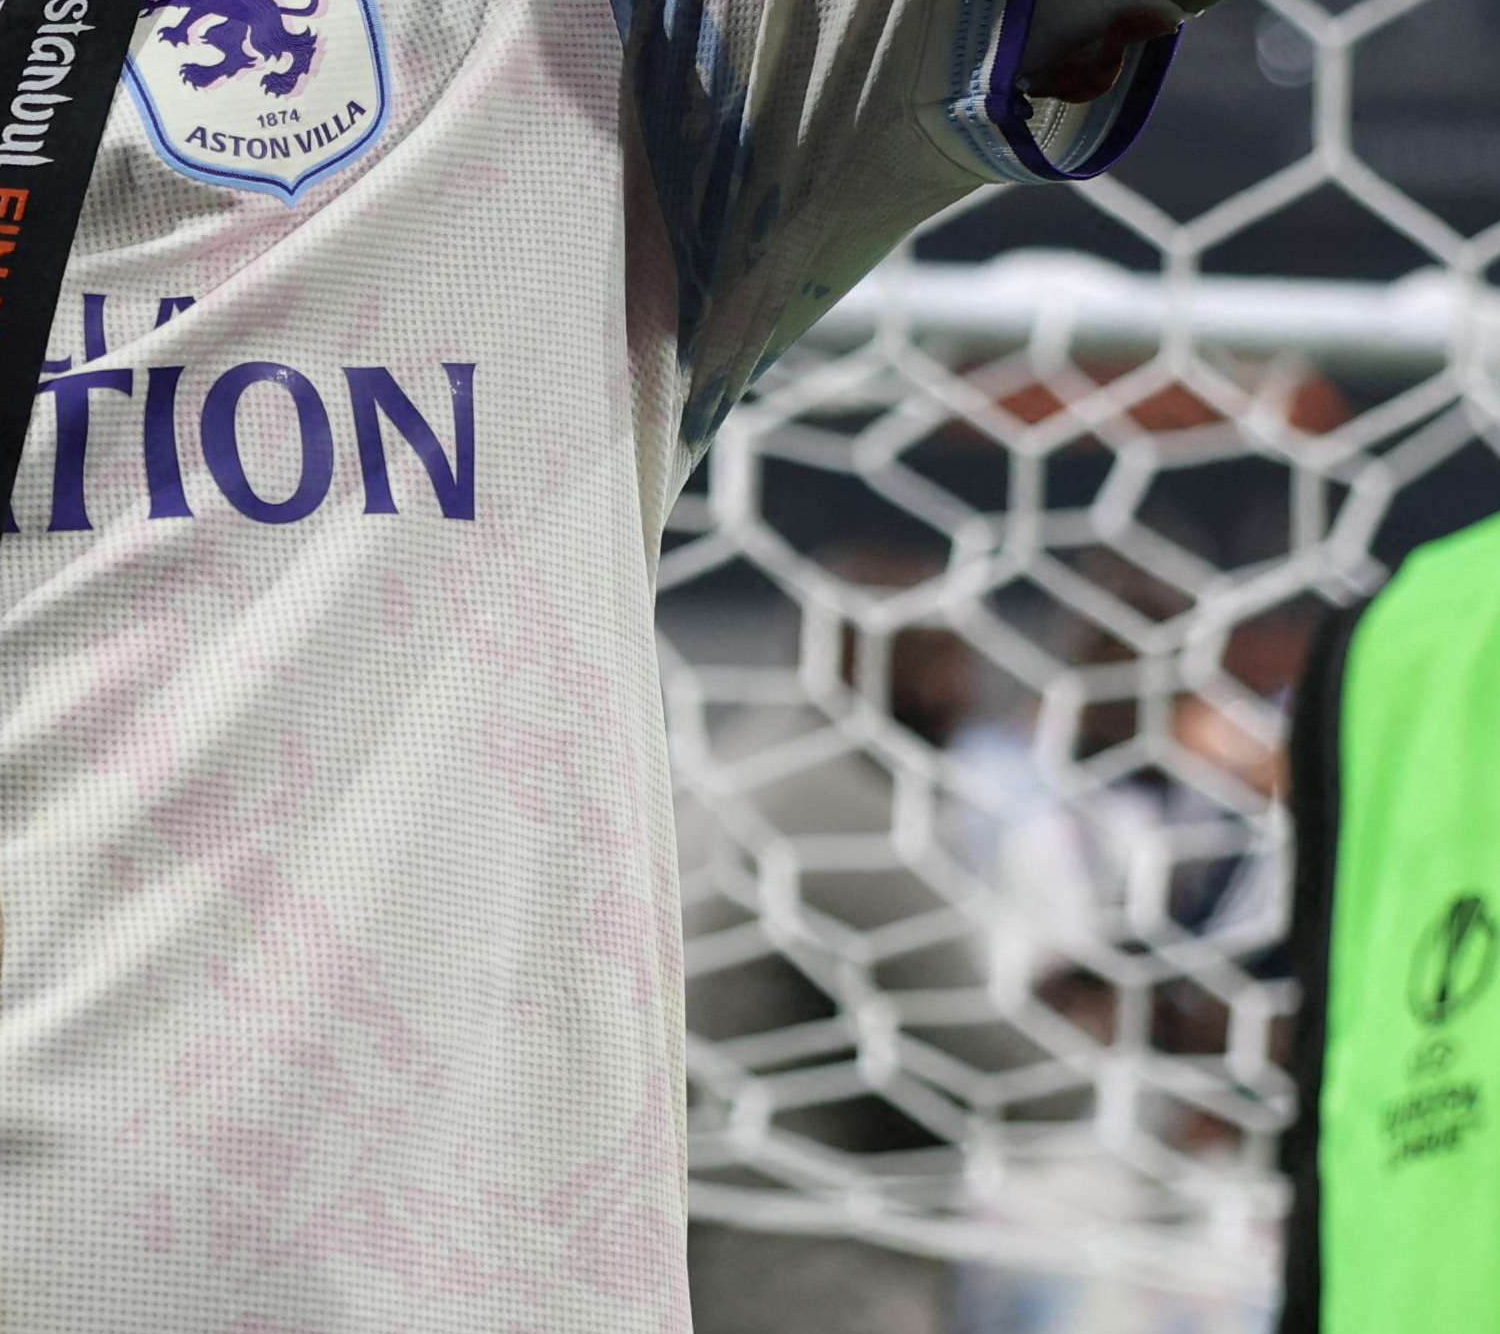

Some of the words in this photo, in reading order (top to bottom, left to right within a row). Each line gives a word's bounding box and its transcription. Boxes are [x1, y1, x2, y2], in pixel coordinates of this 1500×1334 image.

[185, 125, 291, 160] ASTON
[293, 99, 367, 154] VILLA
[256, 108, 301, 128] 1874
